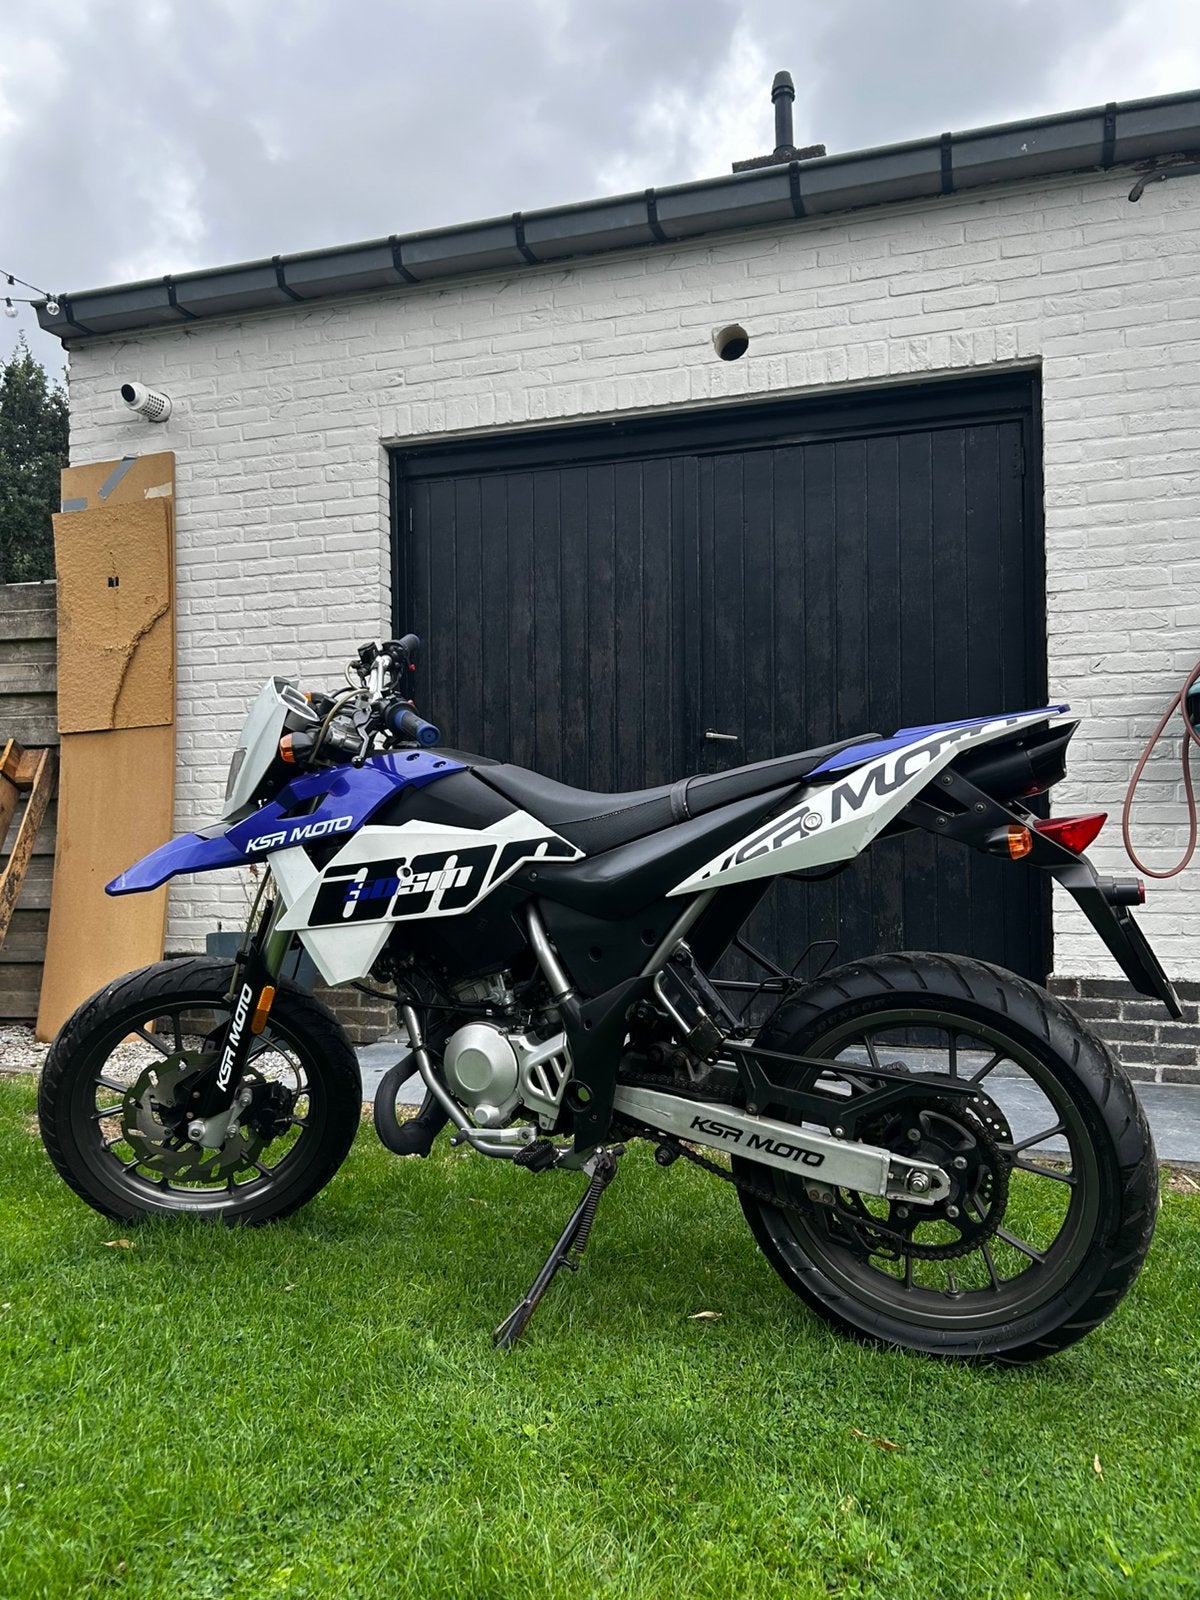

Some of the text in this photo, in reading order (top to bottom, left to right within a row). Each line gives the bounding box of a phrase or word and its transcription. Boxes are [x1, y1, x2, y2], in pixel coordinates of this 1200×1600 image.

[245, 815, 353, 853] KSR MOTO
[216, 983, 253, 1092] KSR MOTO
[690, 1116, 825, 1167] KSR MOTO
